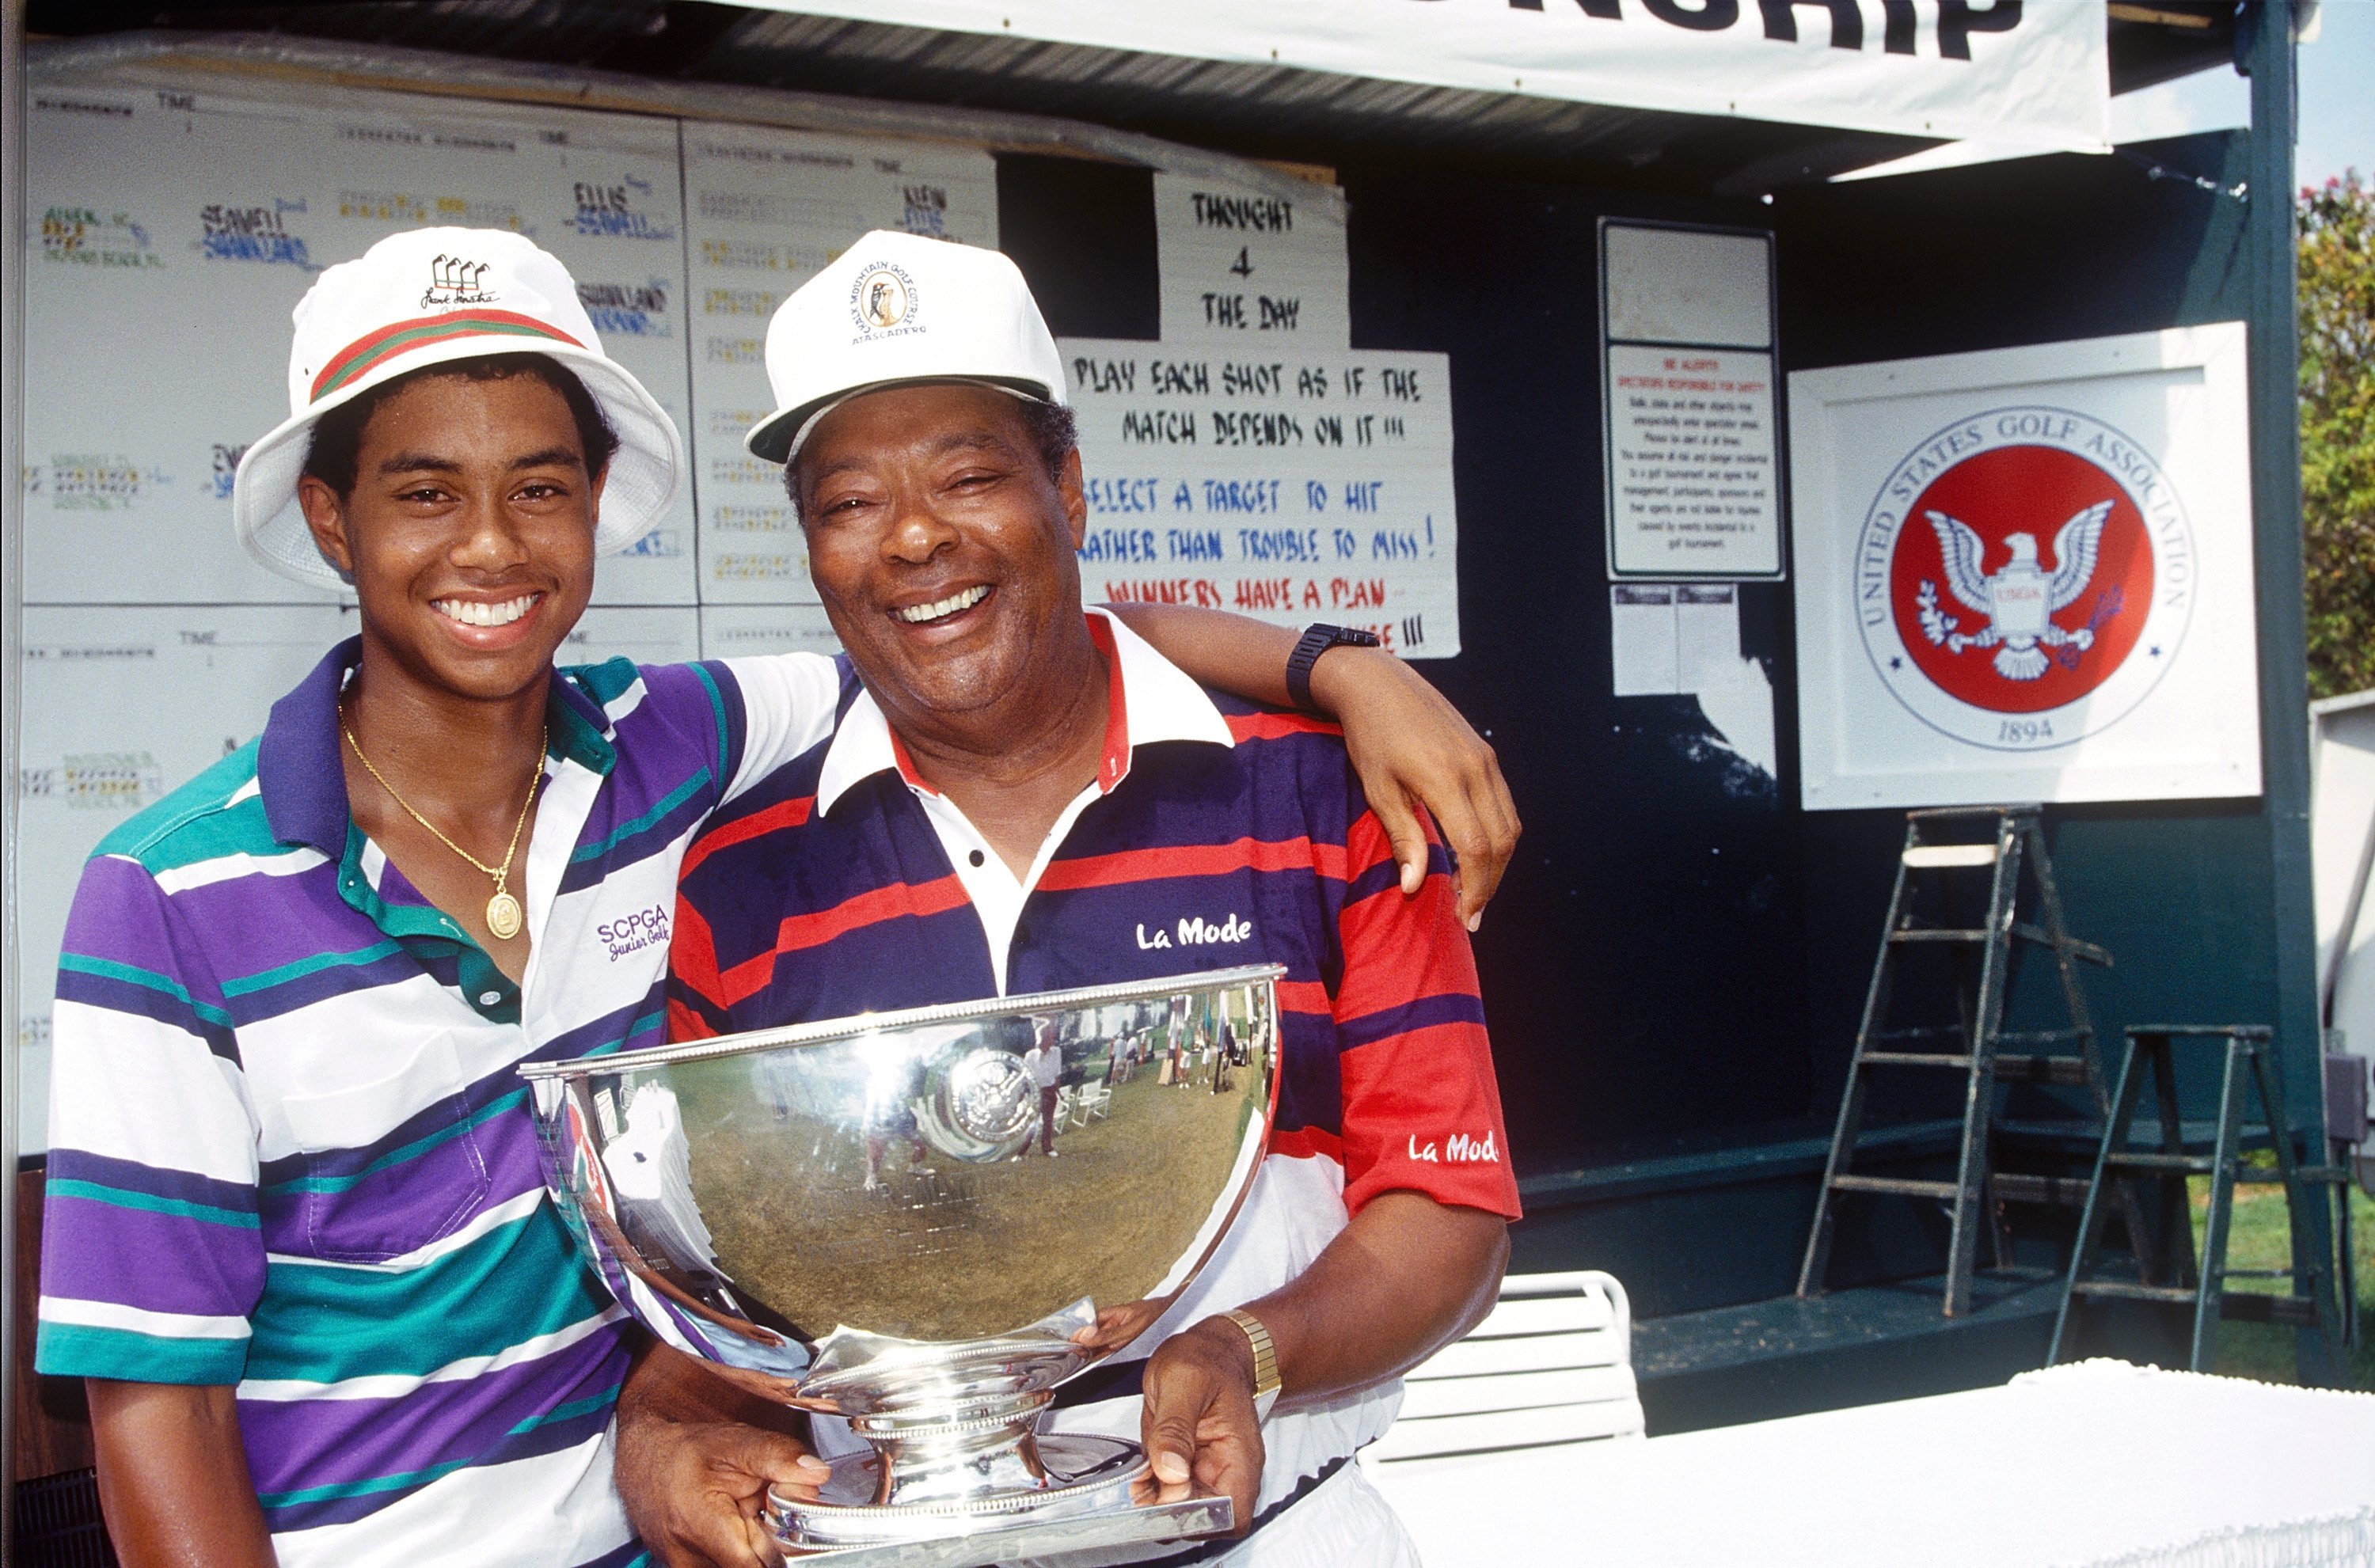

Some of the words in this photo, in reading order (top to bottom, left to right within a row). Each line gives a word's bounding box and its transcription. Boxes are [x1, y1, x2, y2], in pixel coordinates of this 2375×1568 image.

[1192, 192, 1294, 233] THOUGHT
[891, 264, 914, 285] GOLF
[1229, 246, 1256, 279] 4
[850, 261, 888, 305] MOUNTAIN
[851, 306, 871, 333] CHALK
[902, 287, 918, 325] COURSE
[1201, 293, 1246, 329] THE
[1259, 296, 1301, 332] DAY
[852, 326, 926, 346] ATASCADERO
[1074, 357, 1135, 392] PLAY
[1151, 360, 1209, 394] EACH
[1222, 362, 1282, 396] SHOT
[1298, 366, 1328, 398] AS
[1346, 362, 1364, 394] IF
[1381, 367, 1422, 402] THE
[1123, 412, 1197, 445] MATCH
[1213, 413, 1303, 447] DEPENDS
[1315, 415, 1343, 447] ON
[1175, 480, 1193, 512] A
[1203, 478, 1280, 514] TARGET
[1307, 480, 1328, 513] TO
[1345, 480, 1383, 513] HIT
[1863, 512, 1897, 628] UNITED
[1892, 423, 1982, 502] STATES
[1997, 412, 2080, 439] GOLF
[2084, 430, 2191, 611] ASSOCIATION
[1168, 528, 1223, 562] THAN
[1238, 528, 1319, 563] TROUBLE
[1333, 528, 1356, 560] TO
[1105, 579, 1223, 609] WINNERS
[1234, 578, 1294, 611] HAVE
[1304, 579, 1321, 610] A
[1330, 577, 1385, 610] PLAN
[1997, 719, 2054, 742] 1894
[597, 904, 668, 943] SCPGA
[1136, 924, 1172, 950] La
[1178, 913, 1252, 945] Mode
[609, 936, 648, 962] Junior
[648, 924, 670, 944] Golf
[1408, 1133, 1438, 1163] La
[1446, 1129, 1500, 1163] Mod
